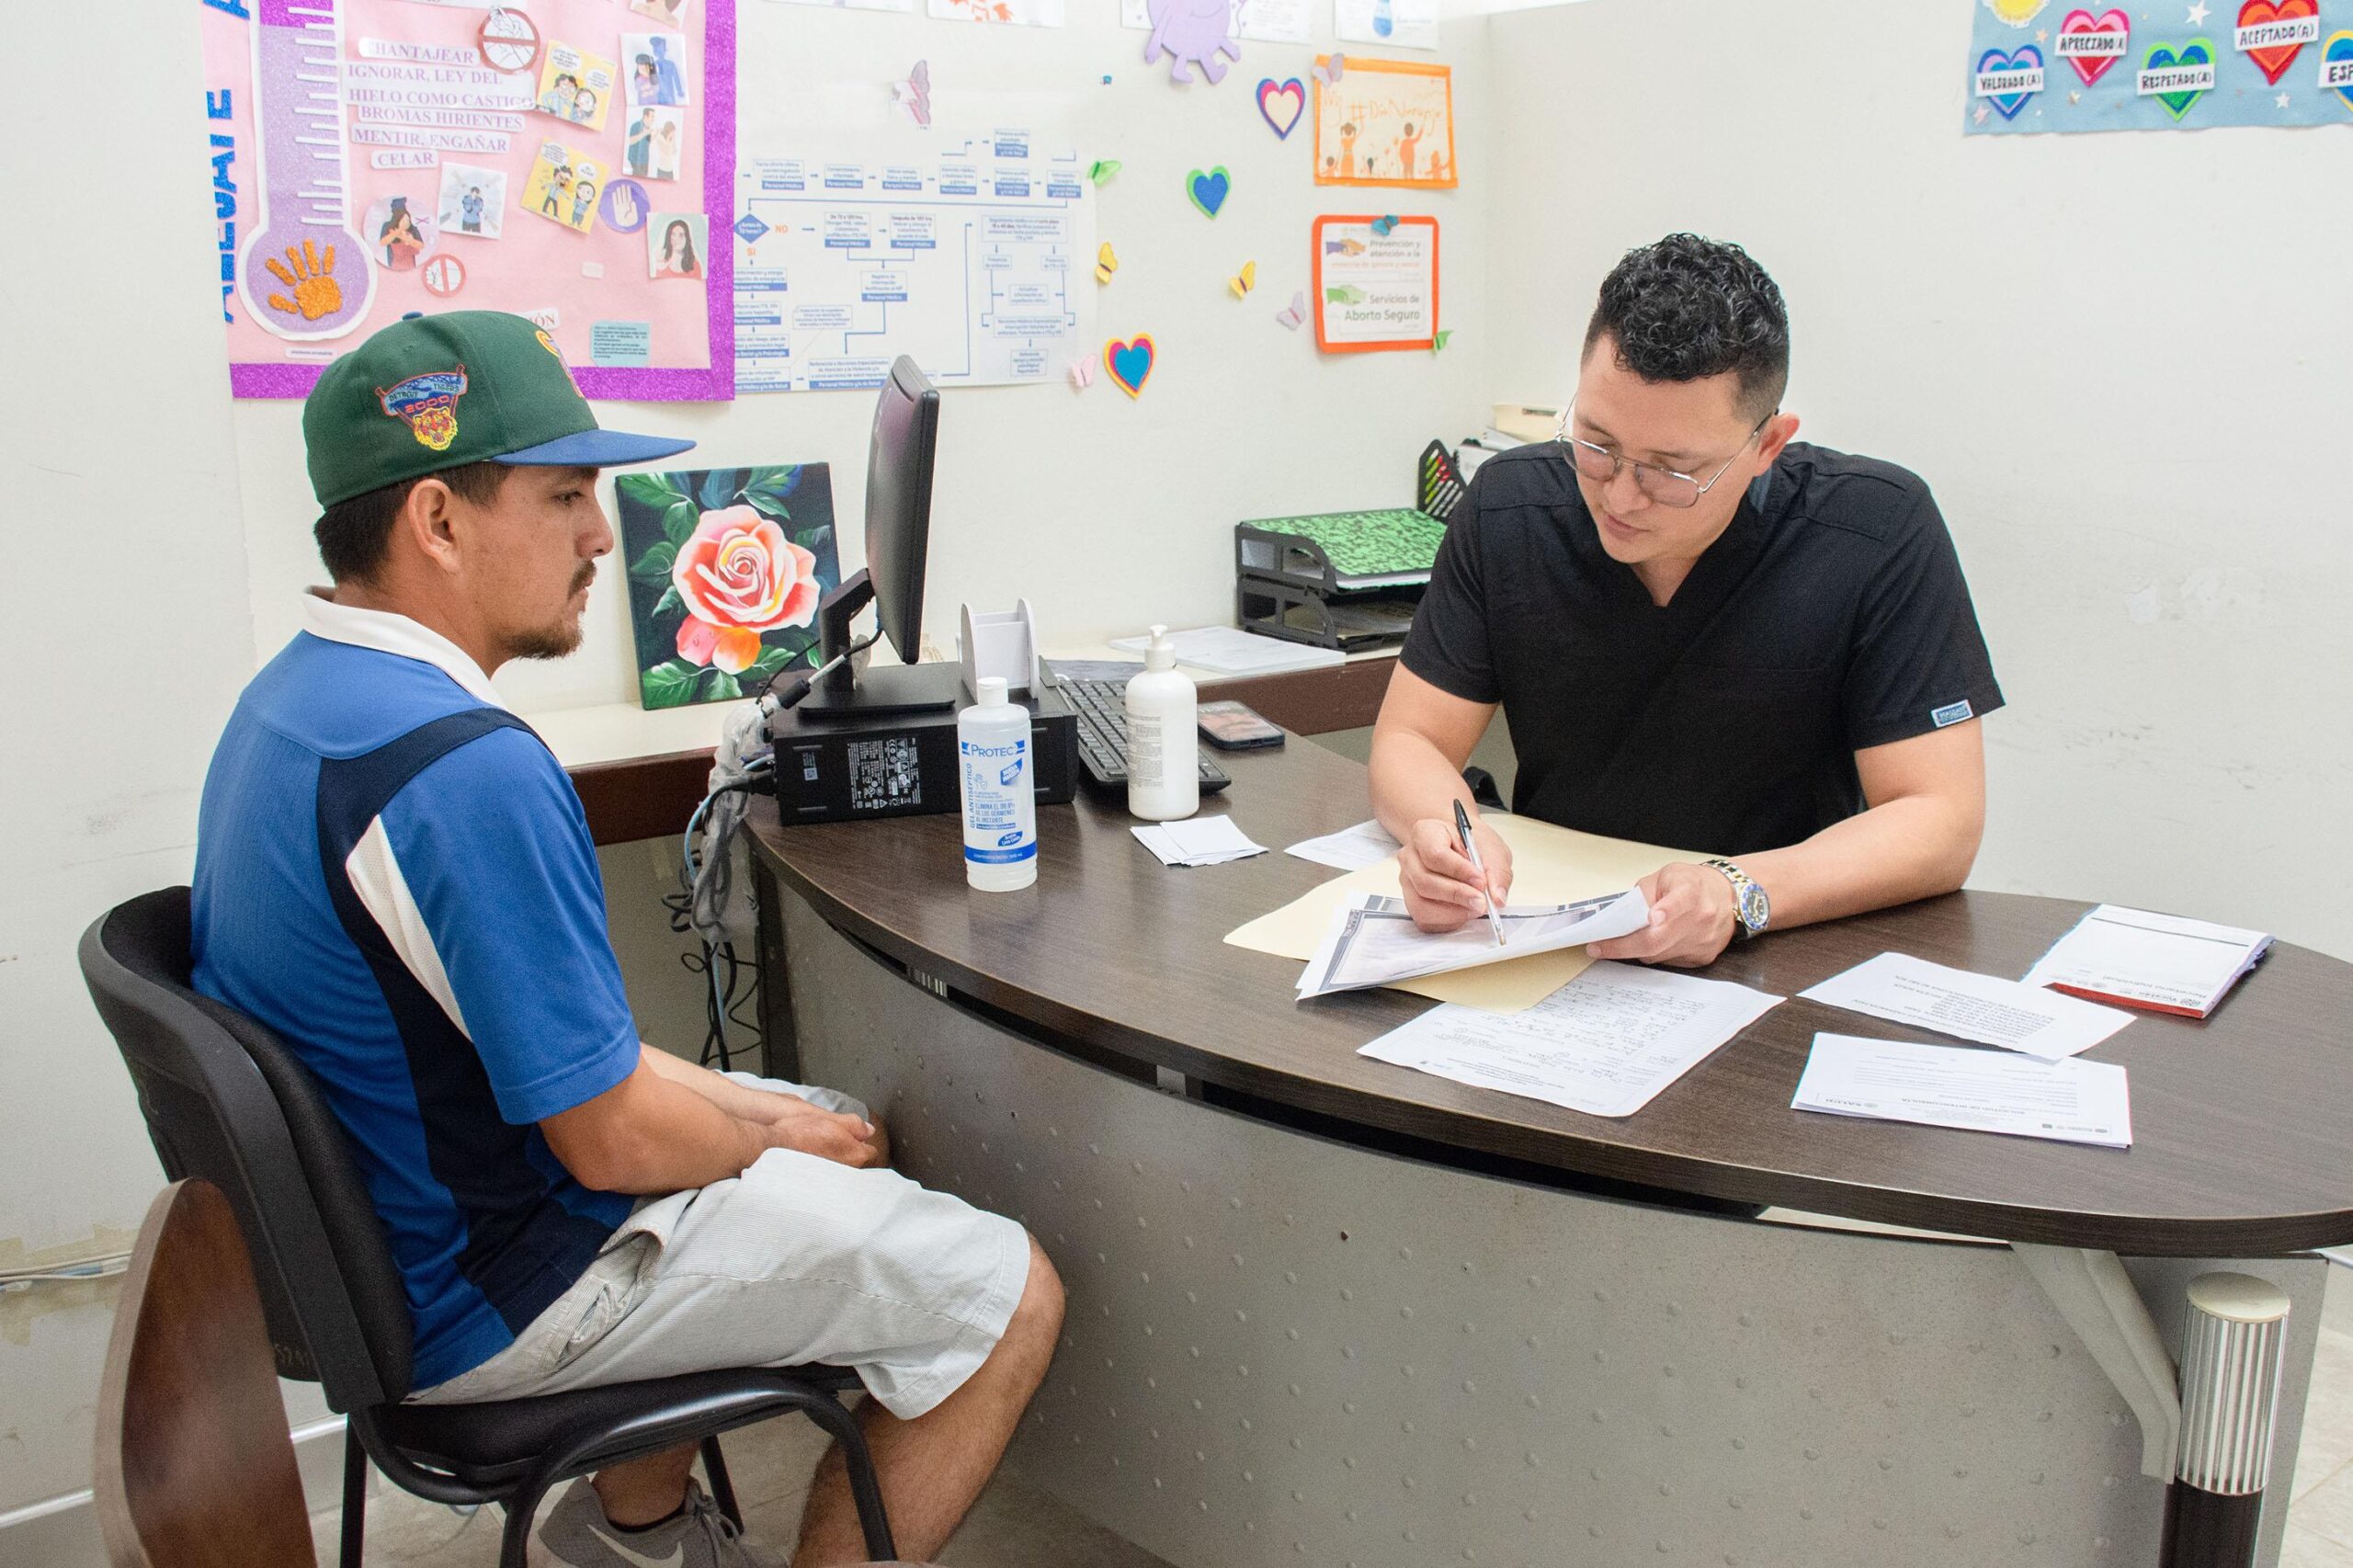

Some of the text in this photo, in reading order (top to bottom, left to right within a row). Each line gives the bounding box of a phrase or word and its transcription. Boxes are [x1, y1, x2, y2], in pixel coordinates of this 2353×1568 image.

[370, 42, 473, 63] HANTAJEAR
[348, 64, 503, 85] IGNORAR, LEY DEL
[349, 88, 533, 108] HIELO COMO CASTIGO
[361, 106, 523, 129] BROMAS HIRIENTES
[354, 129, 506, 152] MENTIR, ENGAÑAR
[378, 153, 434, 166] CELAR
[775, 225, 788, 233] NO
[1370, 294, 1419, 304] Servicios de
[1345, 310, 1420, 323] Aborto Seguro
[389, 391, 418, 403] DETROIT
[404, 395, 449, 413] 2000
[971, 744, 1015, 757] PROTEC
